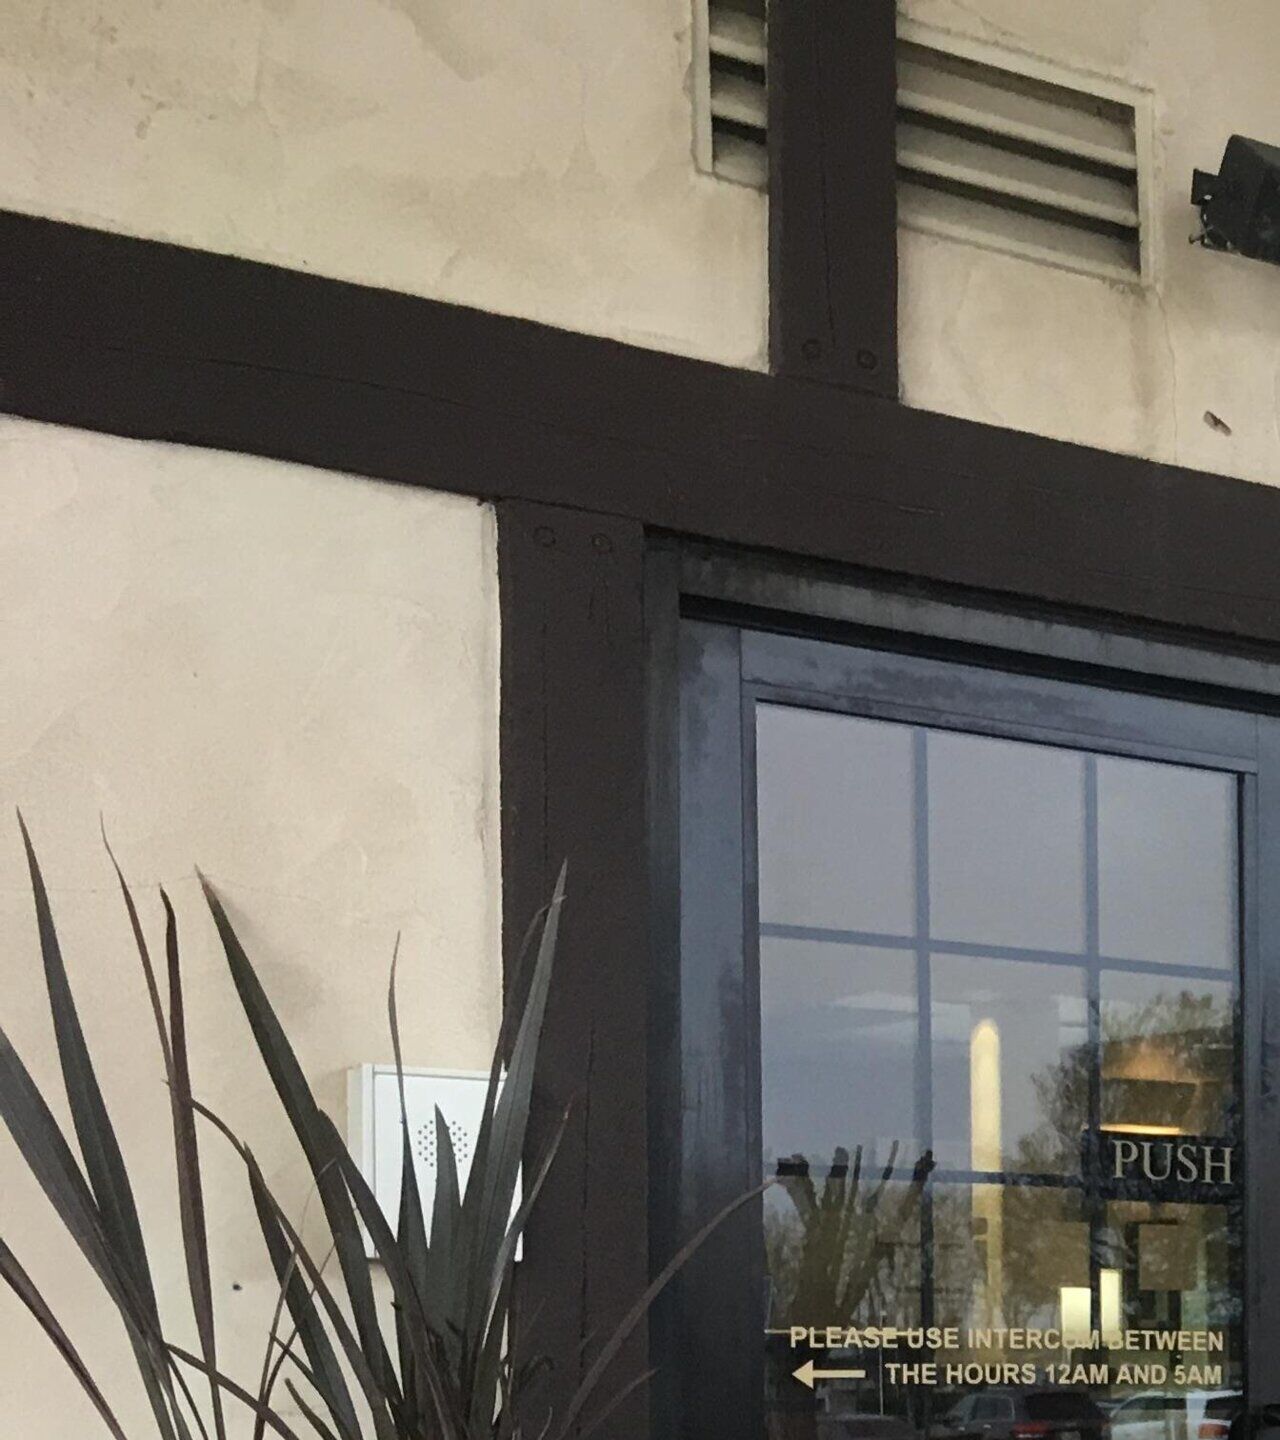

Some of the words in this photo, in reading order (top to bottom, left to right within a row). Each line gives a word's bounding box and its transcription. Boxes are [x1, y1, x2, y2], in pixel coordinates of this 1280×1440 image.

[1112, 1139, 1233, 1185] PUSH
[789, 1326, 899, 1349] PLEASE
[907, 1327, 960, 1349] USE
[1108, 1329, 1224, 1351] BETWEEN
[884, 1363, 937, 1385] THE
[946, 1363, 1037, 1385] HOURS
[1045, 1364, 1109, 1385] 12AM
[1116, 1364, 1167, 1385] AND
[1173, 1364, 1222, 1385] 5AM
